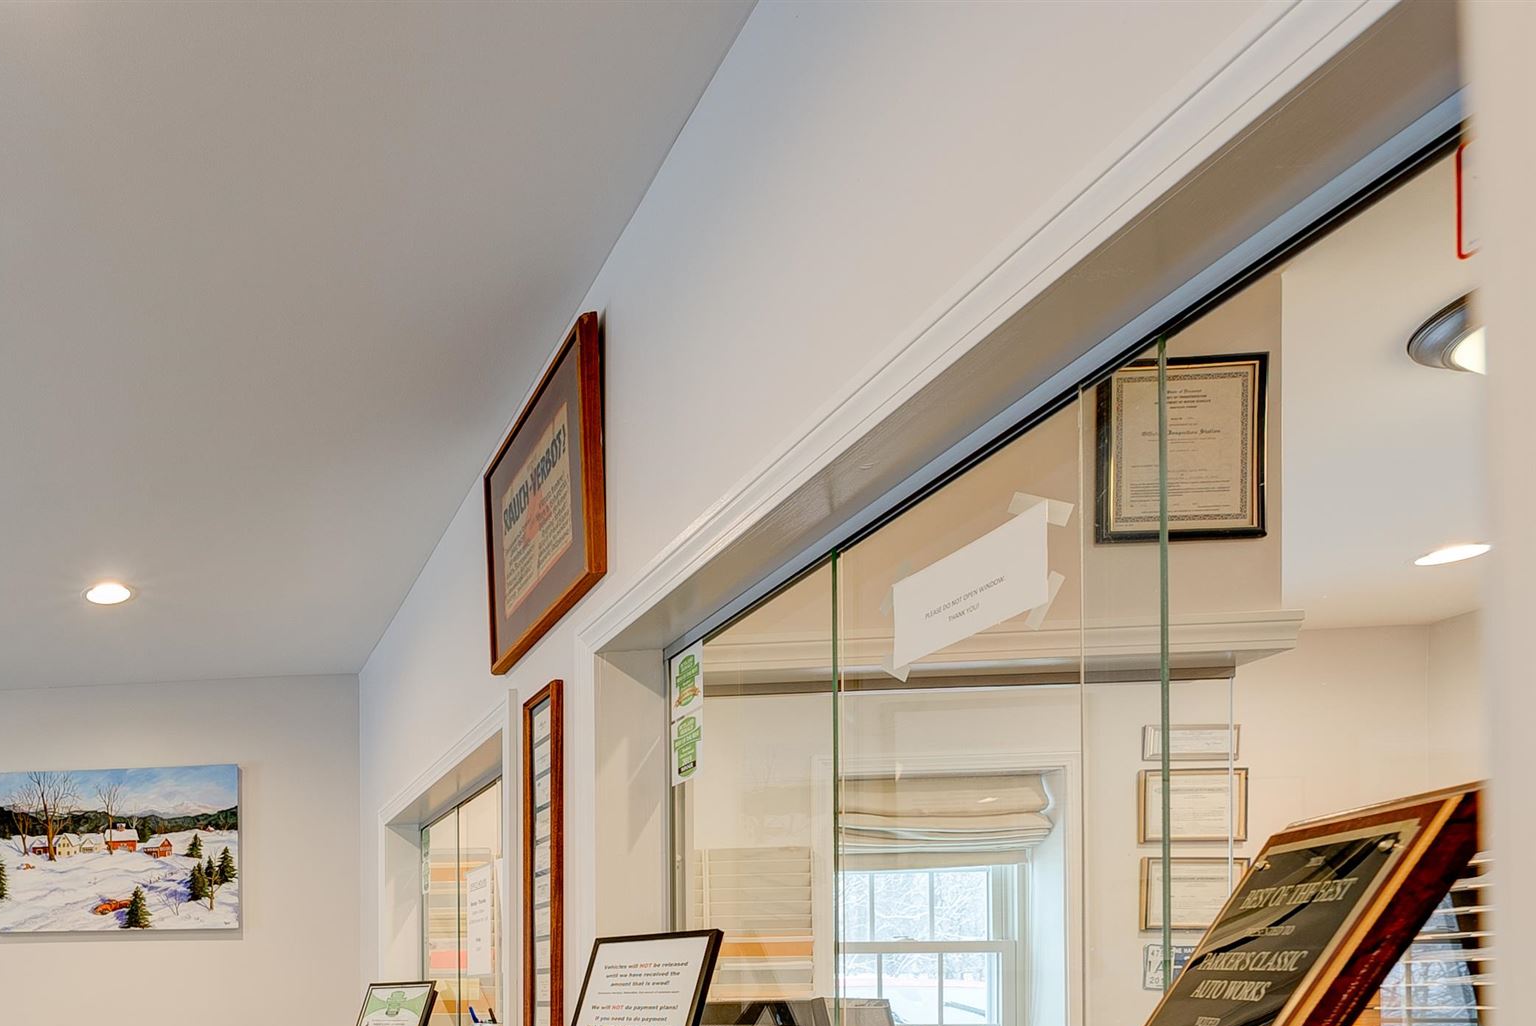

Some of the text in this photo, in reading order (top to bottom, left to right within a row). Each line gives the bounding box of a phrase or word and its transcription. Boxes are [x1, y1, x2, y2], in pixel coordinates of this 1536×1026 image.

[1239, 887, 1276, 910] BEST
[1267, 884, 1295, 907] OF
[1285, 881, 1319, 905] THE
[1312, 877, 1359, 903] BEST
[1196, 950, 1309, 972] PARKER'S CLASSIC
[1190, 979, 1272, 1002] AUTO WORKS
